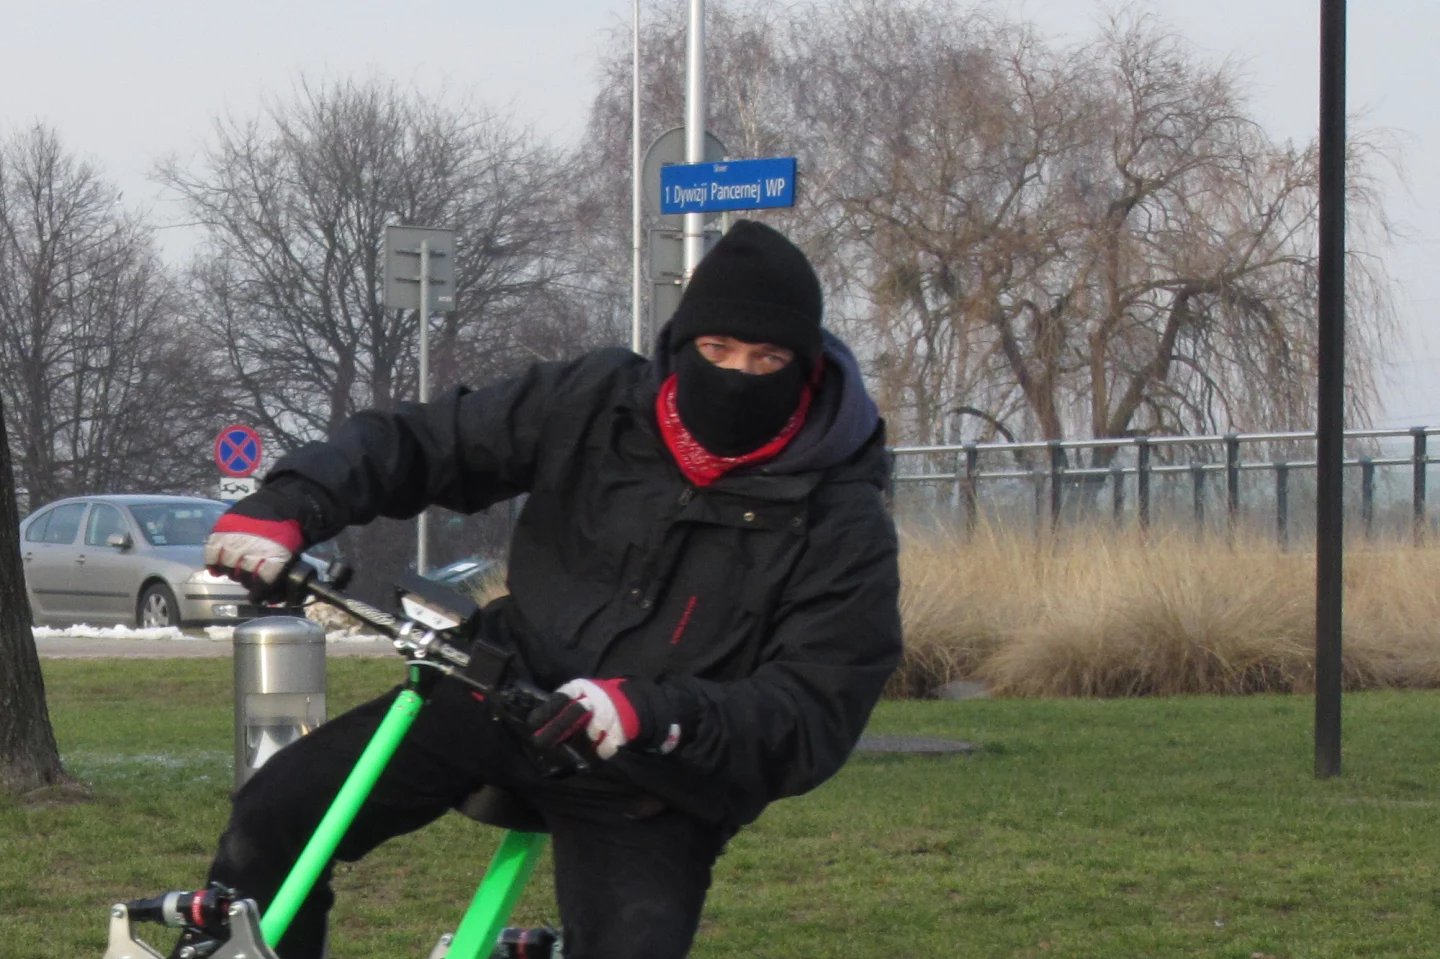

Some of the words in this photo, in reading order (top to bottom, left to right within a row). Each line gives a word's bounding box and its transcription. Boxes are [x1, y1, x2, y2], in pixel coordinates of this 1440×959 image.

[674, 183, 707, 208] Dywizji
[711, 179, 761, 203] Pancernej
[766, 178, 785, 197] WP
